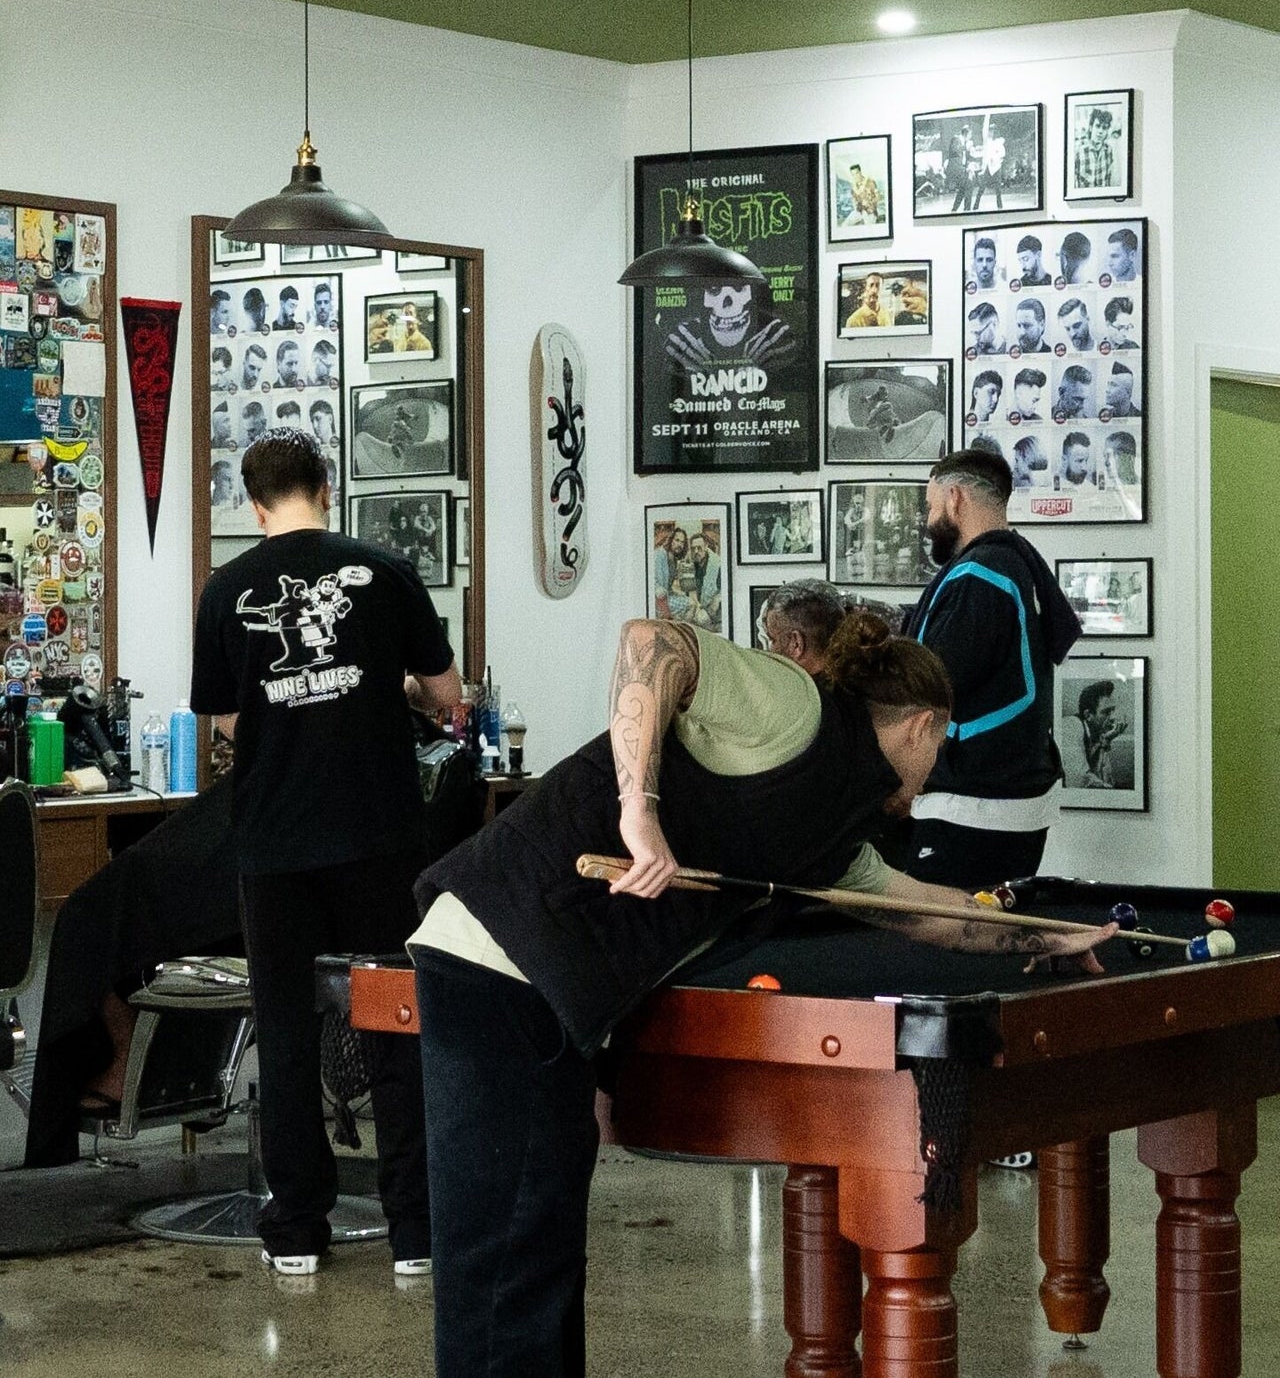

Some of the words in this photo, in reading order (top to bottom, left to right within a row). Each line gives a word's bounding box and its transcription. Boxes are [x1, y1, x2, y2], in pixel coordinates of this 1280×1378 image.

[686, 179, 708, 188] THE
[711, 173, 765, 187] ORIGINAL
[770, 276, 794, 289] JERRY
[656, 296, 686, 307] DANZIG
[773, 290, 795, 302] ONLY
[691, 367, 768, 396] RANCID
[652, 424, 691, 436] SEPT
[695, 424, 708, 435] 11
[713, 421, 758, 431] ORACLE
[762, 419, 800, 429] ARENA
[1032, 499, 1071, 512] UPPERCUT
[45, 642, 69, 662] NYC
[266, 675, 307, 702] NINE
[308, 666, 360, 694] LIVES
